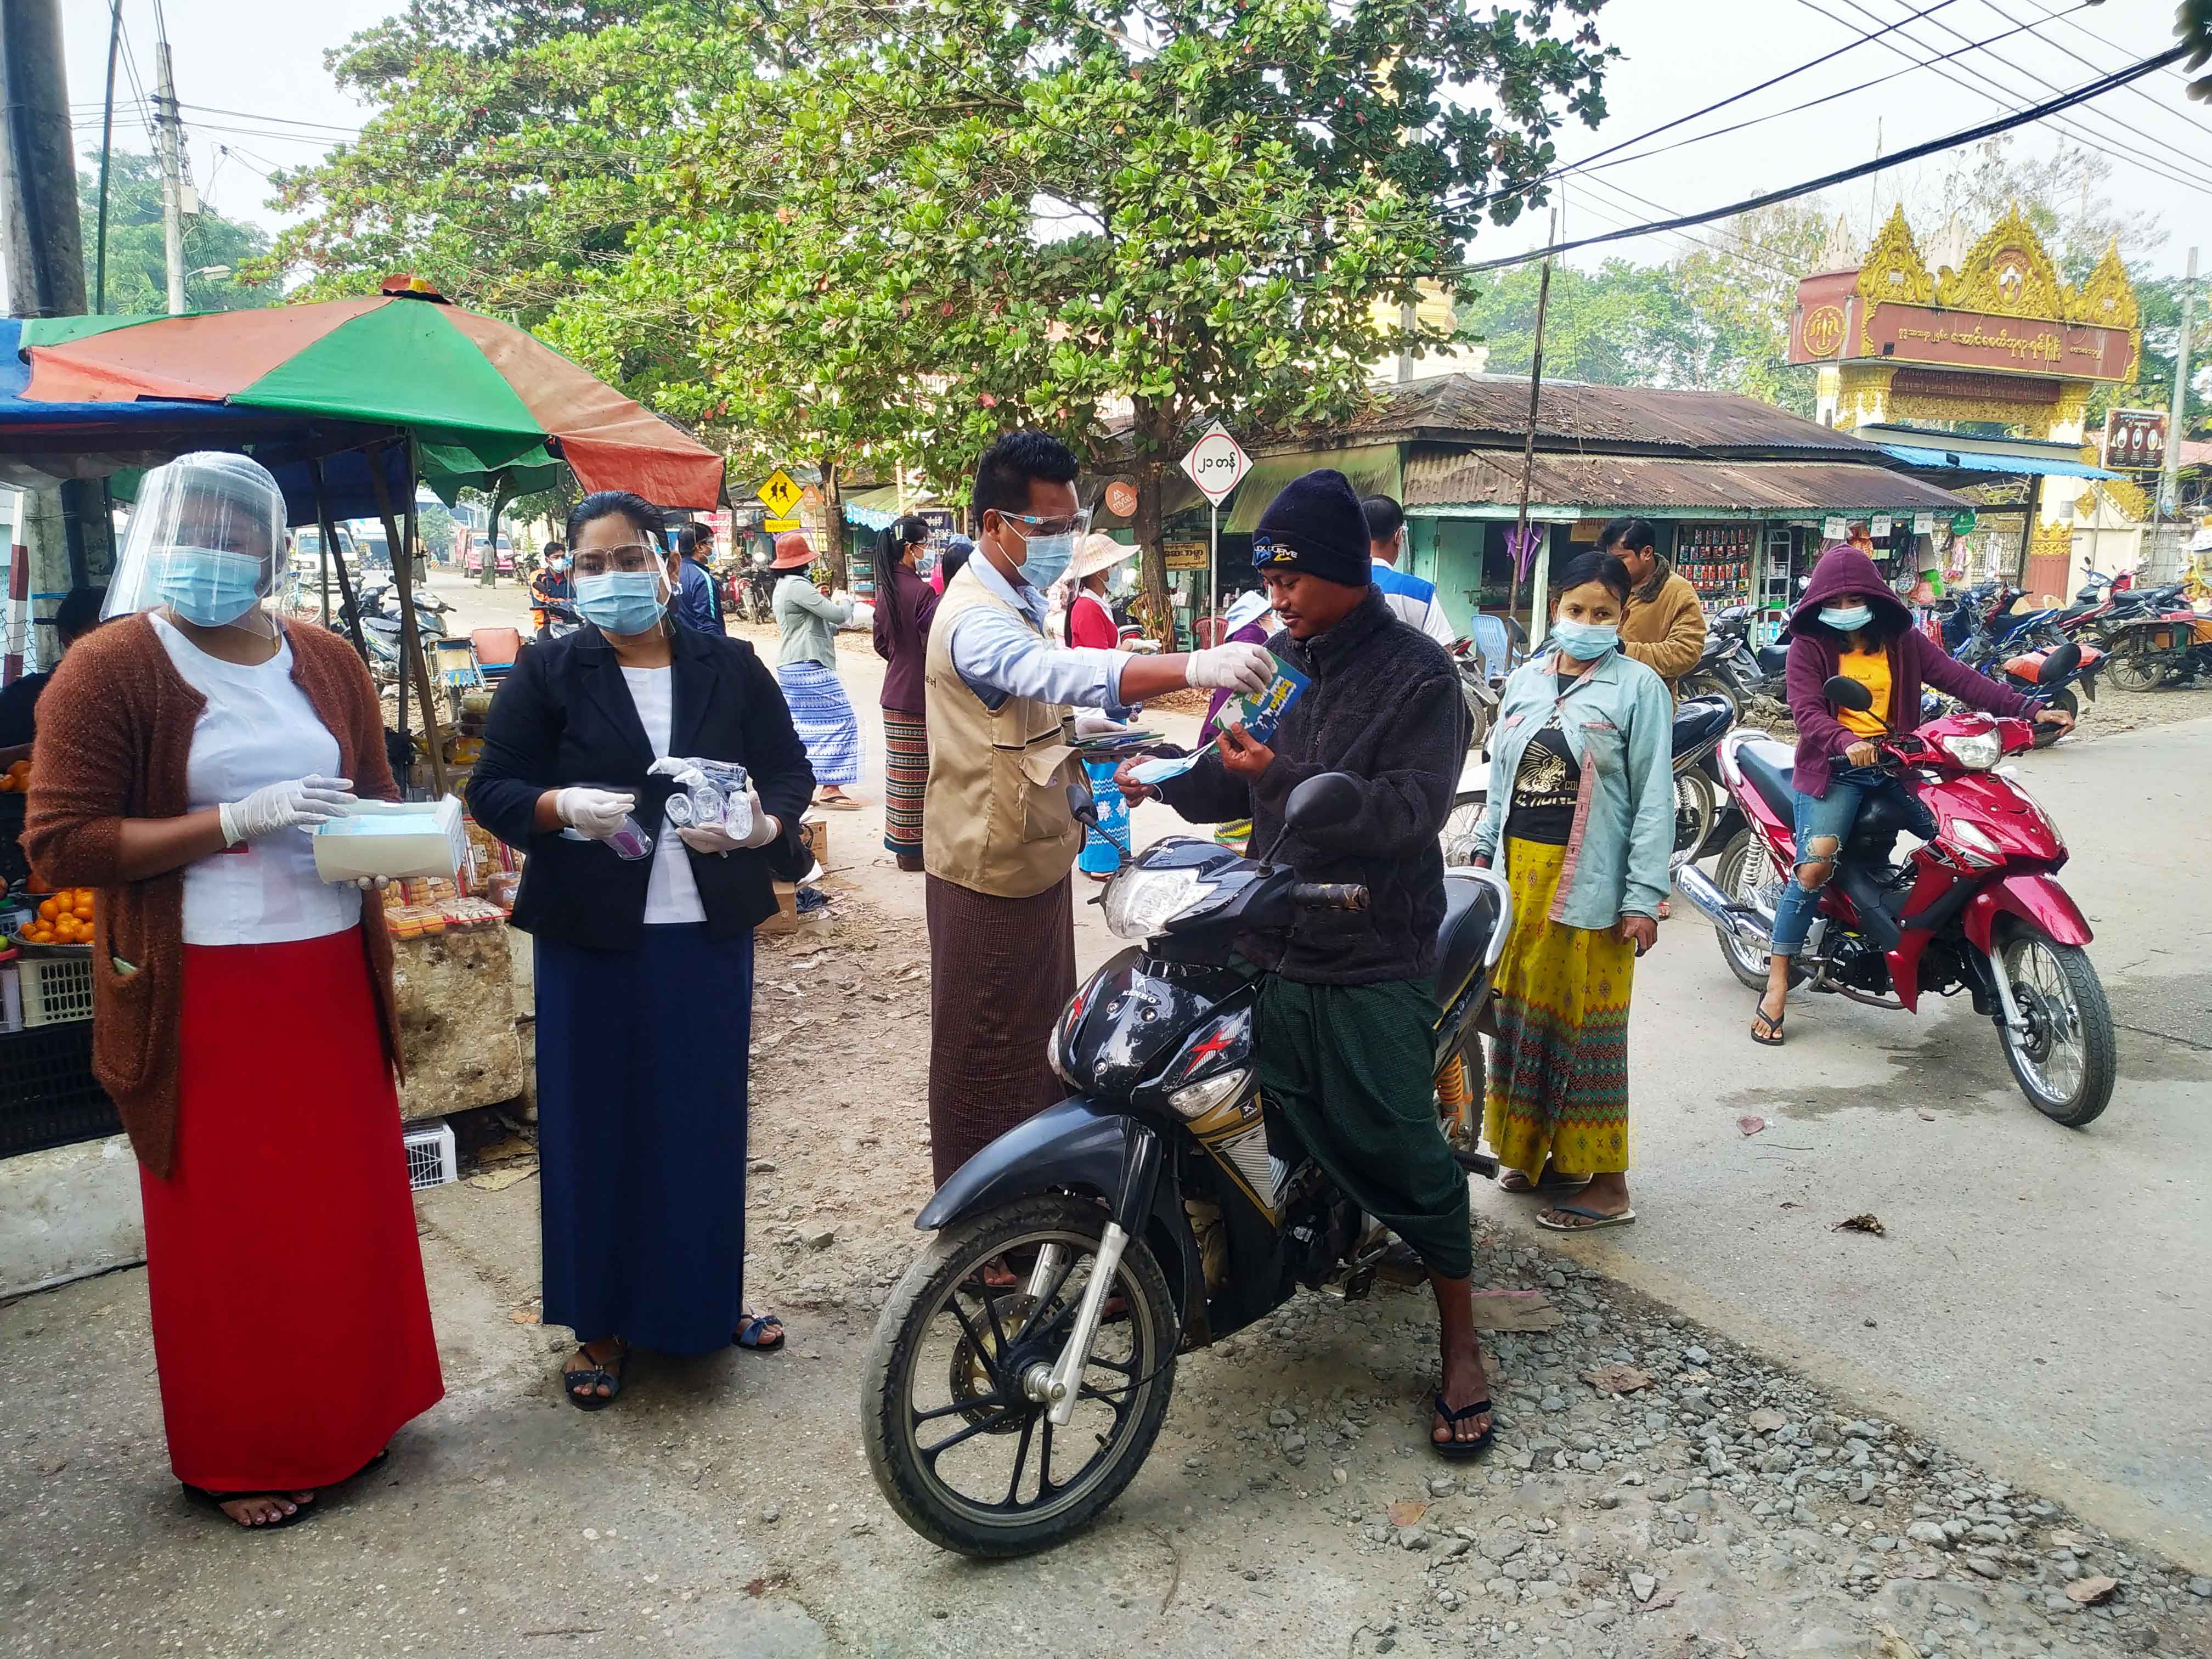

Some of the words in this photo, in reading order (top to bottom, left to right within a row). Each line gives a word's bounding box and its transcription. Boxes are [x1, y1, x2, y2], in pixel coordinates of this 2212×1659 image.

[1216, 452, 1235, 475] တန်
[1267, 545, 1299, 558] CURVE
[1121, 989, 1157, 1004] KENBO
